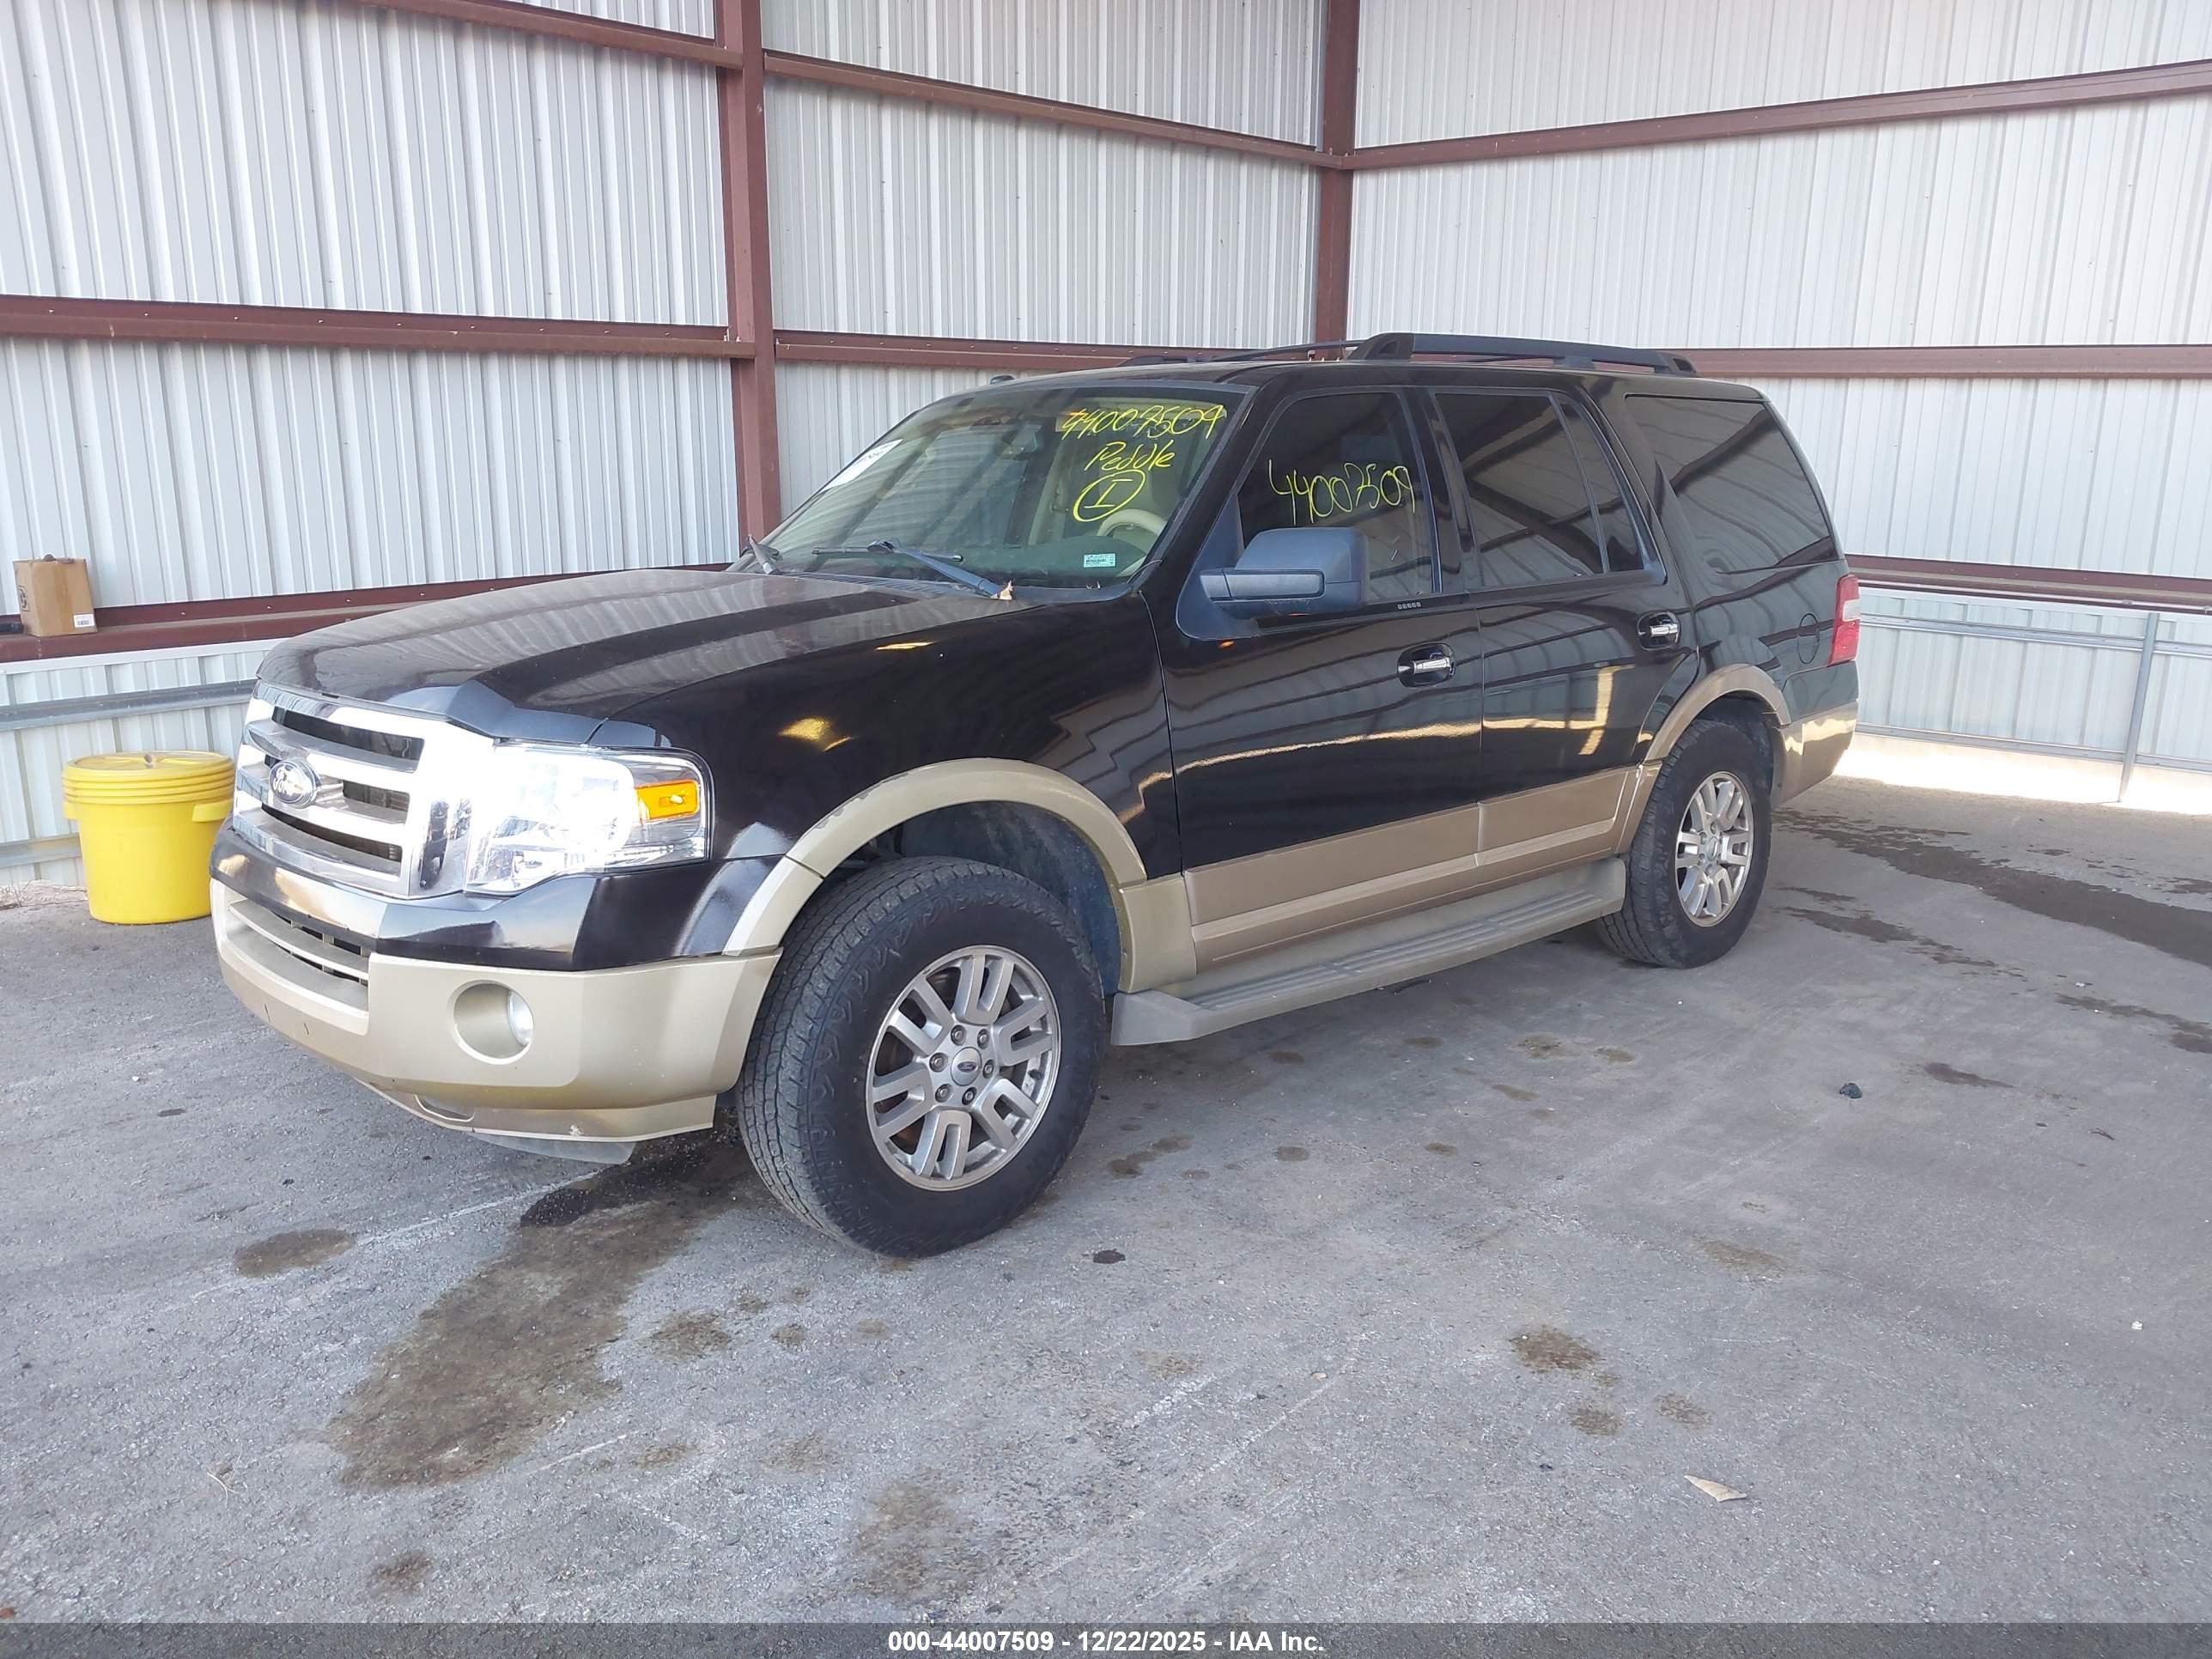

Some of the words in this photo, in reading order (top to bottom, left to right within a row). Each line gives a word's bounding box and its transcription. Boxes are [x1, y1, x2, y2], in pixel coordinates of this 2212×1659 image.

[1061, 405, 1224, 440] 44007509
[1084, 440, 1175, 471] Peddle
[1268, 459, 1416, 526] 44007509
